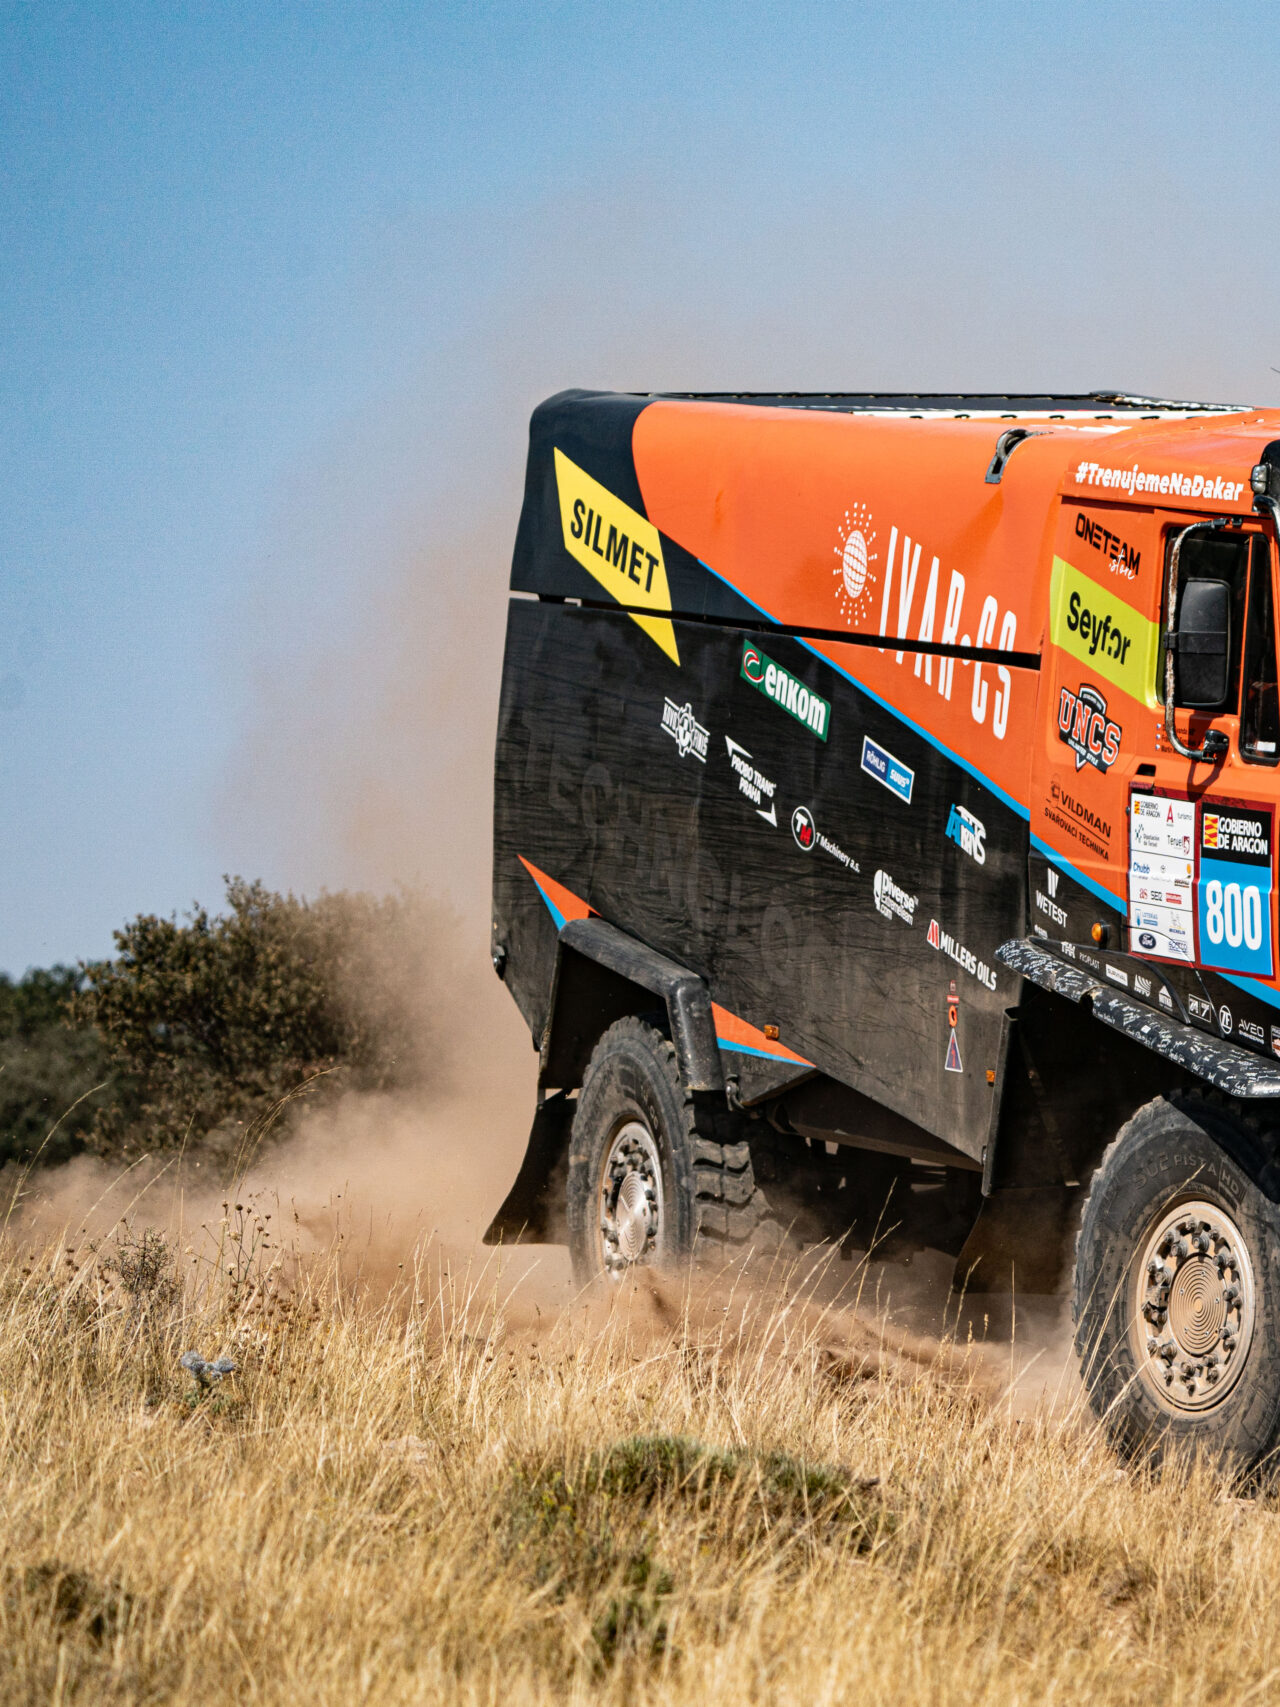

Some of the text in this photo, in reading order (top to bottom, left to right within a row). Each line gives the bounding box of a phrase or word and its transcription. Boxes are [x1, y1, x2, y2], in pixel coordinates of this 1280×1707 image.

[1076, 461, 1244, 502] #TrenujemeNaDakar
[570, 498, 660, 593] SILMET
[1075, 512, 1141, 576] ONETEAM
[1067, 591, 1131, 665] Seyfor
[765, 663, 827, 736] enkom
[1059, 688, 1121, 766] UNCS
[739, 778, 761, 805] PRAHA
[1061, 791, 1111, 838] VILDMAN
[1219, 817, 1262, 837] GOBIERNO
[819, 835, 851, 867] Machinery
[1079, 832, 1109, 861] TECHNIKA
[1219, 833, 1268, 855] DE ARAGON
[1133, 861, 1150, 874] Chubb
[882, 871, 914, 914] Diverse
[1036, 890, 1068, 928] WETEST
[1206, 879, 1262, 950] 800
[941, 931, 977, 975] MILLERS
[977, 961, 997, 991] OILS
[1221, 1011, 1231, 1030] ZF
[1238, 1018, 1264, 1038] AVEO
